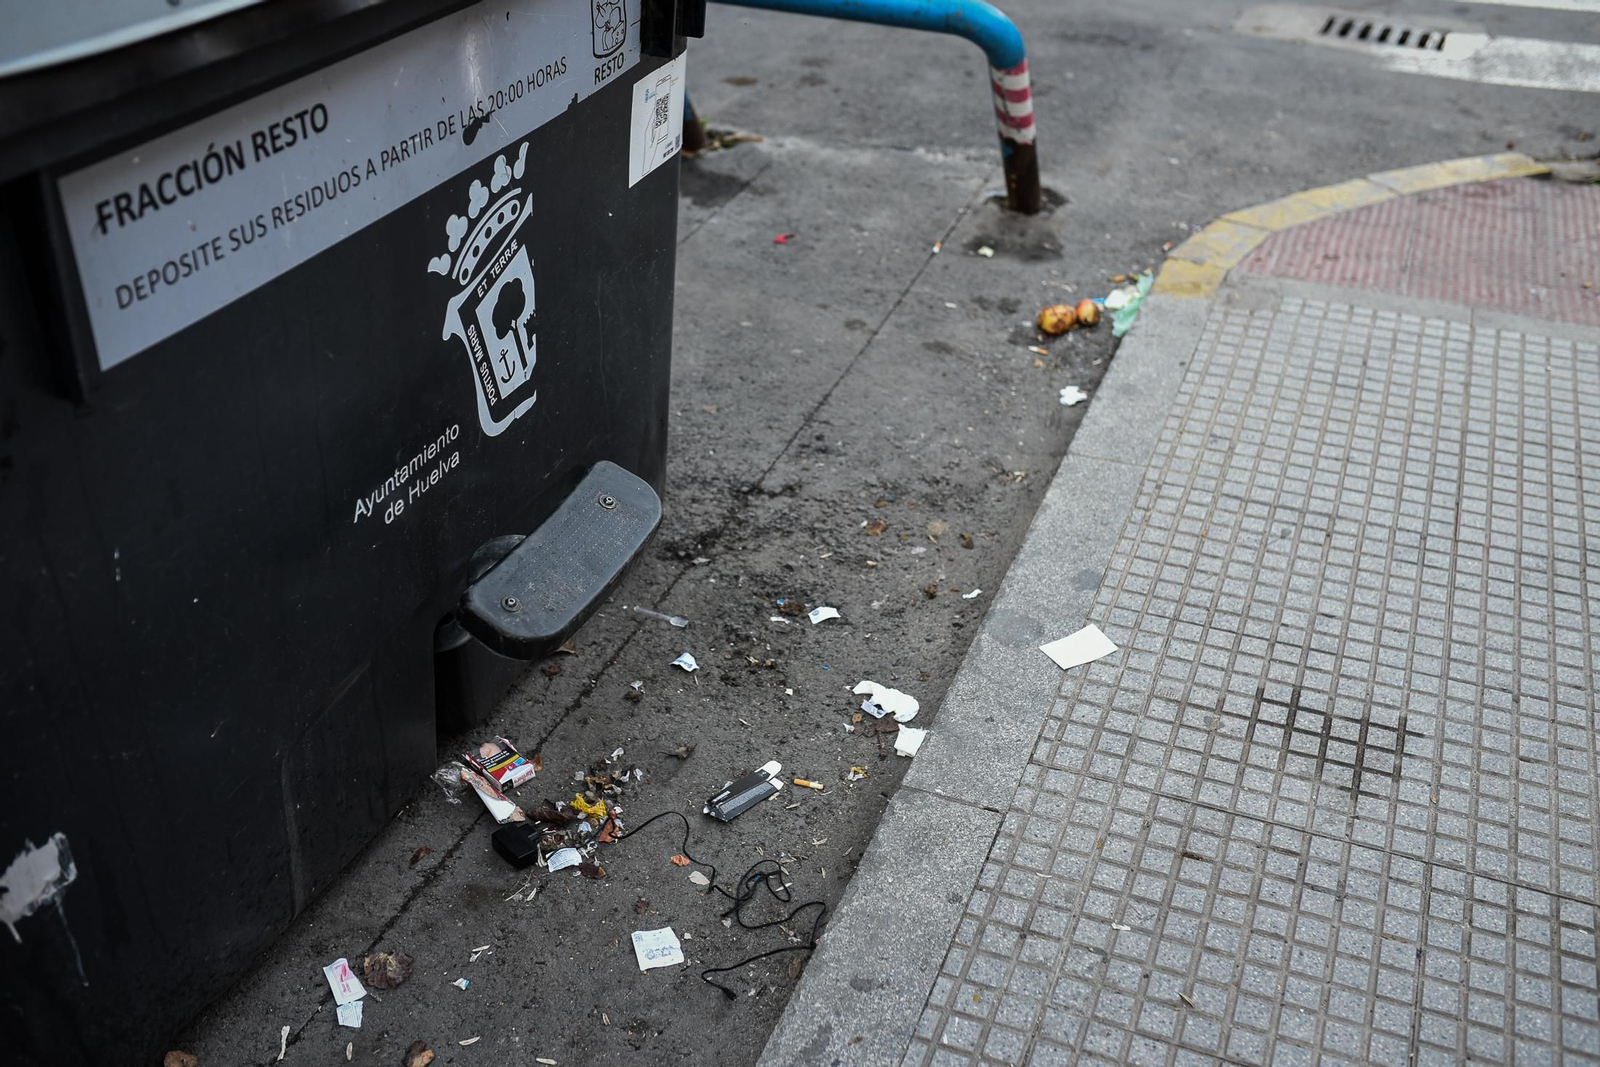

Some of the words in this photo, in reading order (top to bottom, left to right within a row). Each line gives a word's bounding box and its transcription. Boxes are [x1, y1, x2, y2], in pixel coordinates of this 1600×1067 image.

[594, 51, 625, 86] RESTO
[95, 140, 246, 236] FRACCIÓN
[251, 103, 329, 163] RESTO
[115, 236, 226, 310] DEPOSITE
[228, 214, 268, 252] SUS
[271, 165, 362, 230] RESIDUOS
[365, 158, 378, 181] A
[380, 127, 433, 171] PARTIR
[437, 114, 457, 141] DE
[459, 100, 485, 130] LAS
[487, 79, 524, 116] 20:00
[526, 56, 568, 92] HORAS
[477, 278, 488, 298] ET
[467, 324, 484, 363] MARIS
[480, 361, 498, 407] PORTUS
[353, 424, 460, 524] Ayuntamiento
[384, 499, 405, 525] de
[408, 451, 460, 505] Huelva
